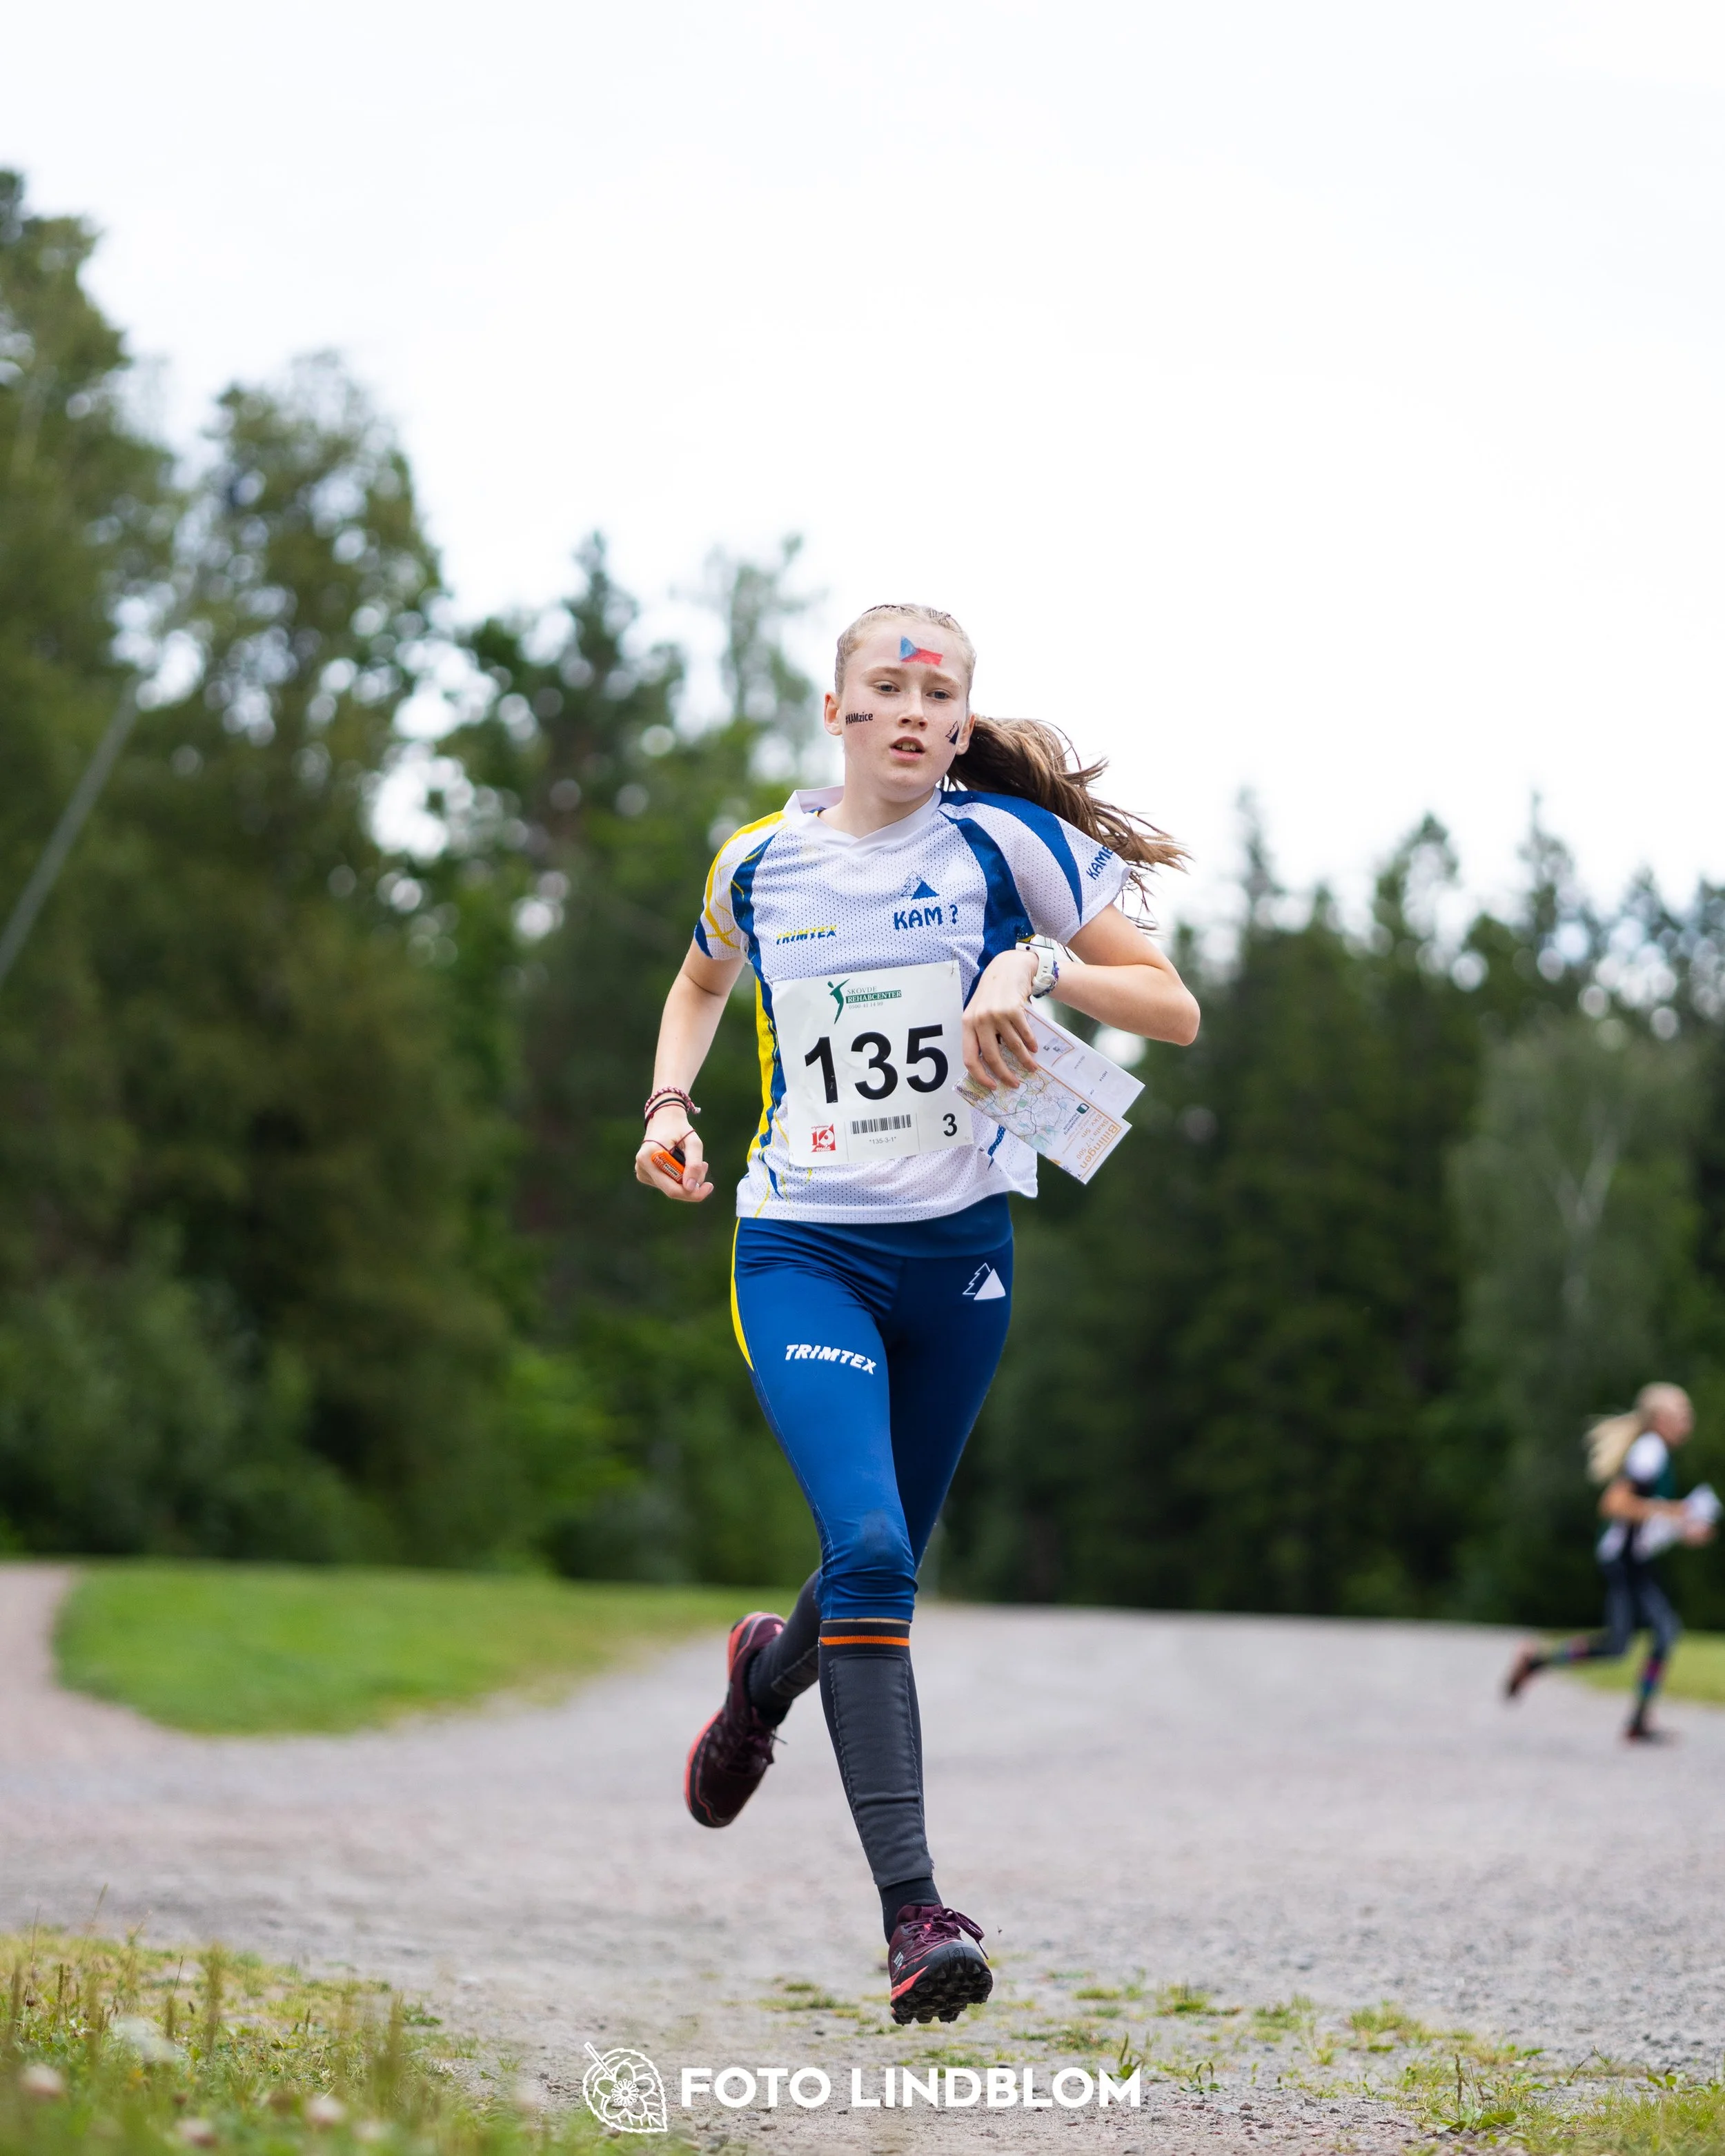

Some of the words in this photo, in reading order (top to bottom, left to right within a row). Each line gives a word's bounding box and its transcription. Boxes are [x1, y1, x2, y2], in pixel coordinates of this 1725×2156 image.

[894, 907, 943, 931] KAM
[776, 924, 838, 945] TRIMTEX
[847, 991, 901, 1003] REHABCENTER
[805, 1024, 949, 1104] 135
[943, 1113, 958, 1137] 3
[1078, 1122, 1118, 1171] Billingen
[785, 1344, 877, 1375] TRIMTEX
